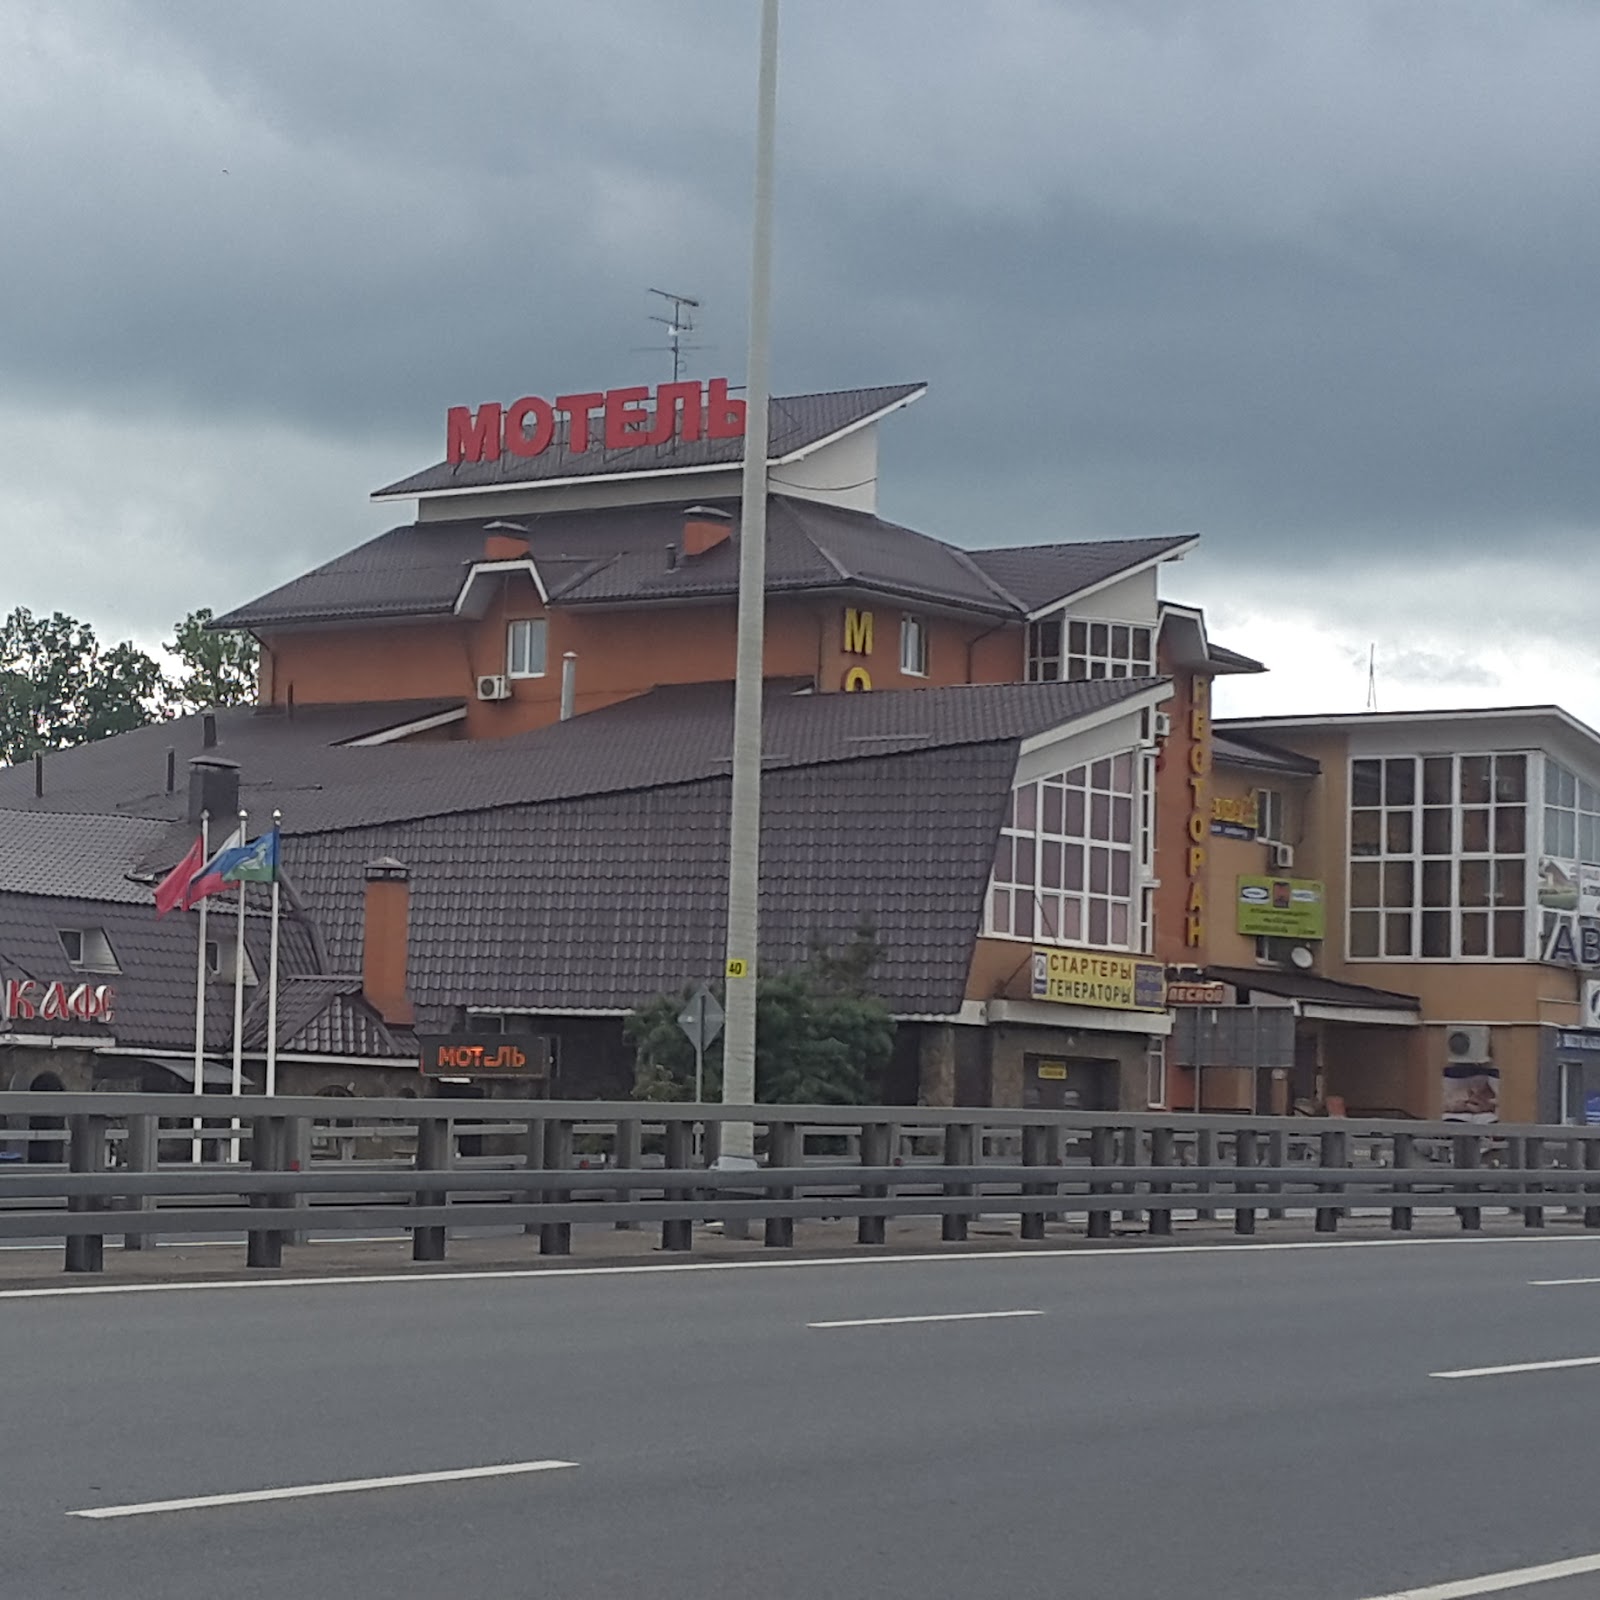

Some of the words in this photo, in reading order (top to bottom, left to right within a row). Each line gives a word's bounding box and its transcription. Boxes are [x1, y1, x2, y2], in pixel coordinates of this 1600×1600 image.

[447, 378, 746, 464] МОТЕЛЬ
[1187, 674, 1209, 948] РЕСТОРАН
[729, 962, 742, 975] 40
[1050, 954, 1132, 980] СТАРТЕРЫ
[6, 980, 115, 1022] КАФЕ
[1049, 978, 1131, 1004] ГЕНЕРАТОРЫ
